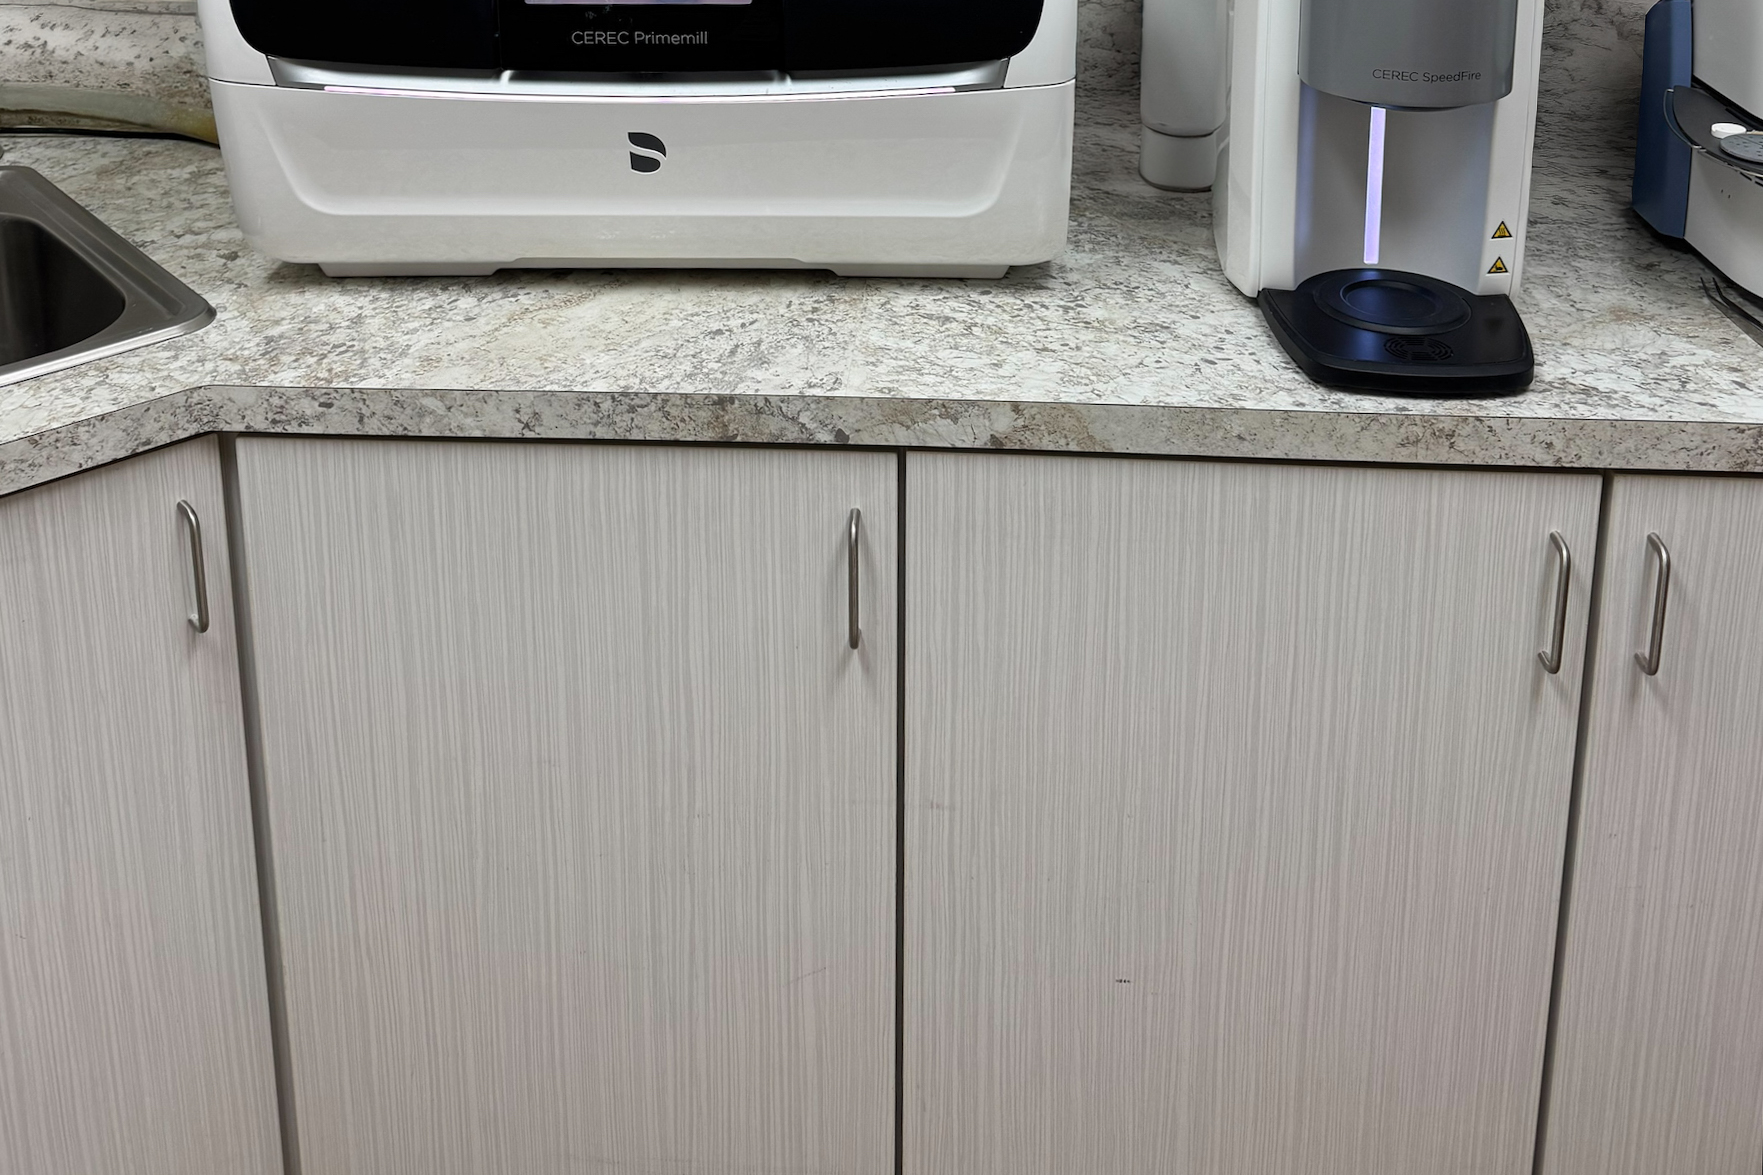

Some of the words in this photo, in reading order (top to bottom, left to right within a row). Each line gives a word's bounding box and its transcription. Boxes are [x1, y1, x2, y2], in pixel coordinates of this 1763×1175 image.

[571, 31, 630, 45] CEREC
[634, 31, 708, 45] Primemill
[1372, 68, 1419, 82] CEREC
[1422, 71, 1482, 84] SpeedFire
